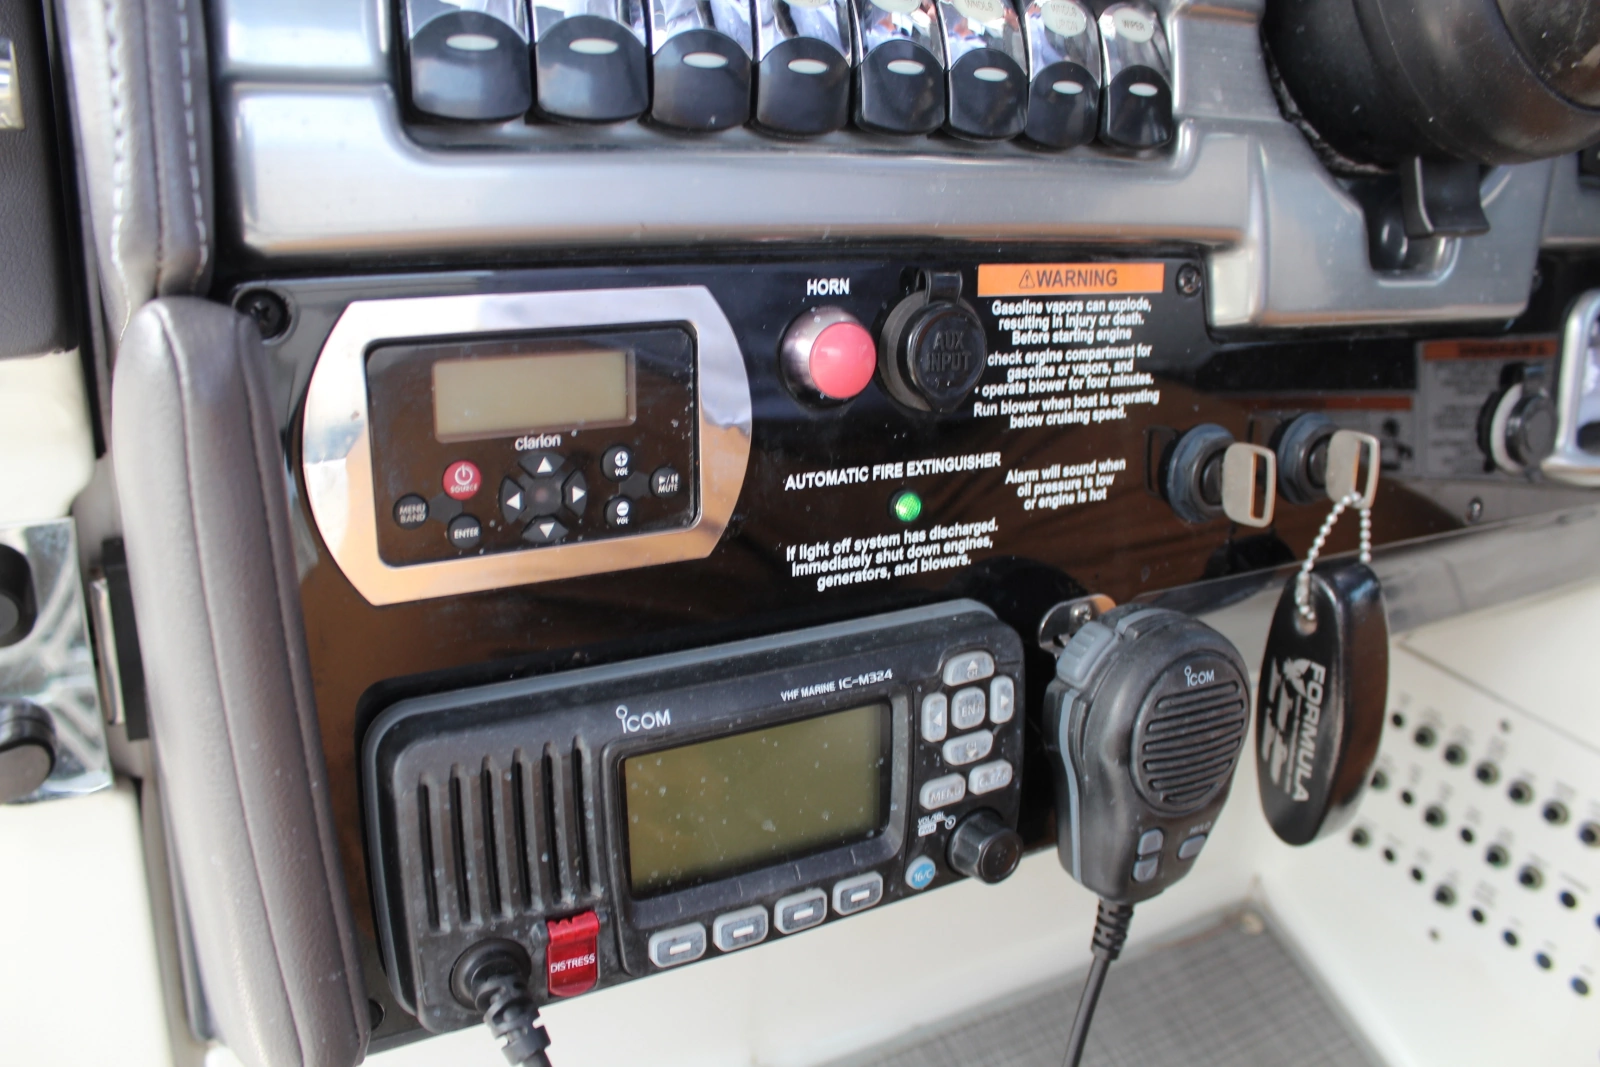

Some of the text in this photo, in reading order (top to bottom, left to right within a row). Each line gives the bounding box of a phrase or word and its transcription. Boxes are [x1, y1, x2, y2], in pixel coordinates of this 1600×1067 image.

[807, 278, 850, 296] HORN
[1037, 269, 1117, 287] WARNING
[992, 296, 1151, 316] Gasoline vapors can explode,
[999, 312, 1144, 332] resulting in injury or death.
[933, 332, 964, 350] AUX
[1012, 328, 1131, 345] Before starting engine
[926, 352, 972, 372] INPUT
[987, 343, 1152, 366] check engine compartment for
[1007, 359, 1133, 383] gasoline or vapors, and
[982, 373, 1153, 398] operate blower for four minutes.
[974, 389, 1160, 417] Run blower when boat is operating
[1010, 406, 1126, 429] below cruising speed.
[515, 433, 561, 450] clarion
[615, 467, 629, 476] VOL
[785, 452, 1001, 491] AUTOMATIC FIRE EXTINGUISHER
[1005, 458, 1126, 484] Alarm will sound when
[450, 483, 478, 493] SOURCE
[658, 483, 678, 493] MUTE
[1017, 473, 1115, 498] oil pressure is low
[1024, 486, 1107, 510] or engine is hot
[400, 503, 426, 515] MENU
[401, 512, 425, 523] BAND
[616, 515, 629, 525] VOL
[454, 528, 479, 539] ENTER
[786, 517, 998, 561] If light off system has discharged.
[875, 548, 904, 564] shut
[907, 543, 941, 560] down
[943, 536, 993, 556] engines,
[817, 553, 971, 592] generators, and blowers.
[781, 668, 893, 701] VHF MARINE IC-M324
[961, 703, 981, 718] ENT
[1293, 662, 1326, 801] FORMULA
[979, 772, 1009, 787] CLEAR
[930, 786, 962, 802] MENU
[914, 868, 933, 882] 16/C
[551, 953, 595, 974] DISTRESS
